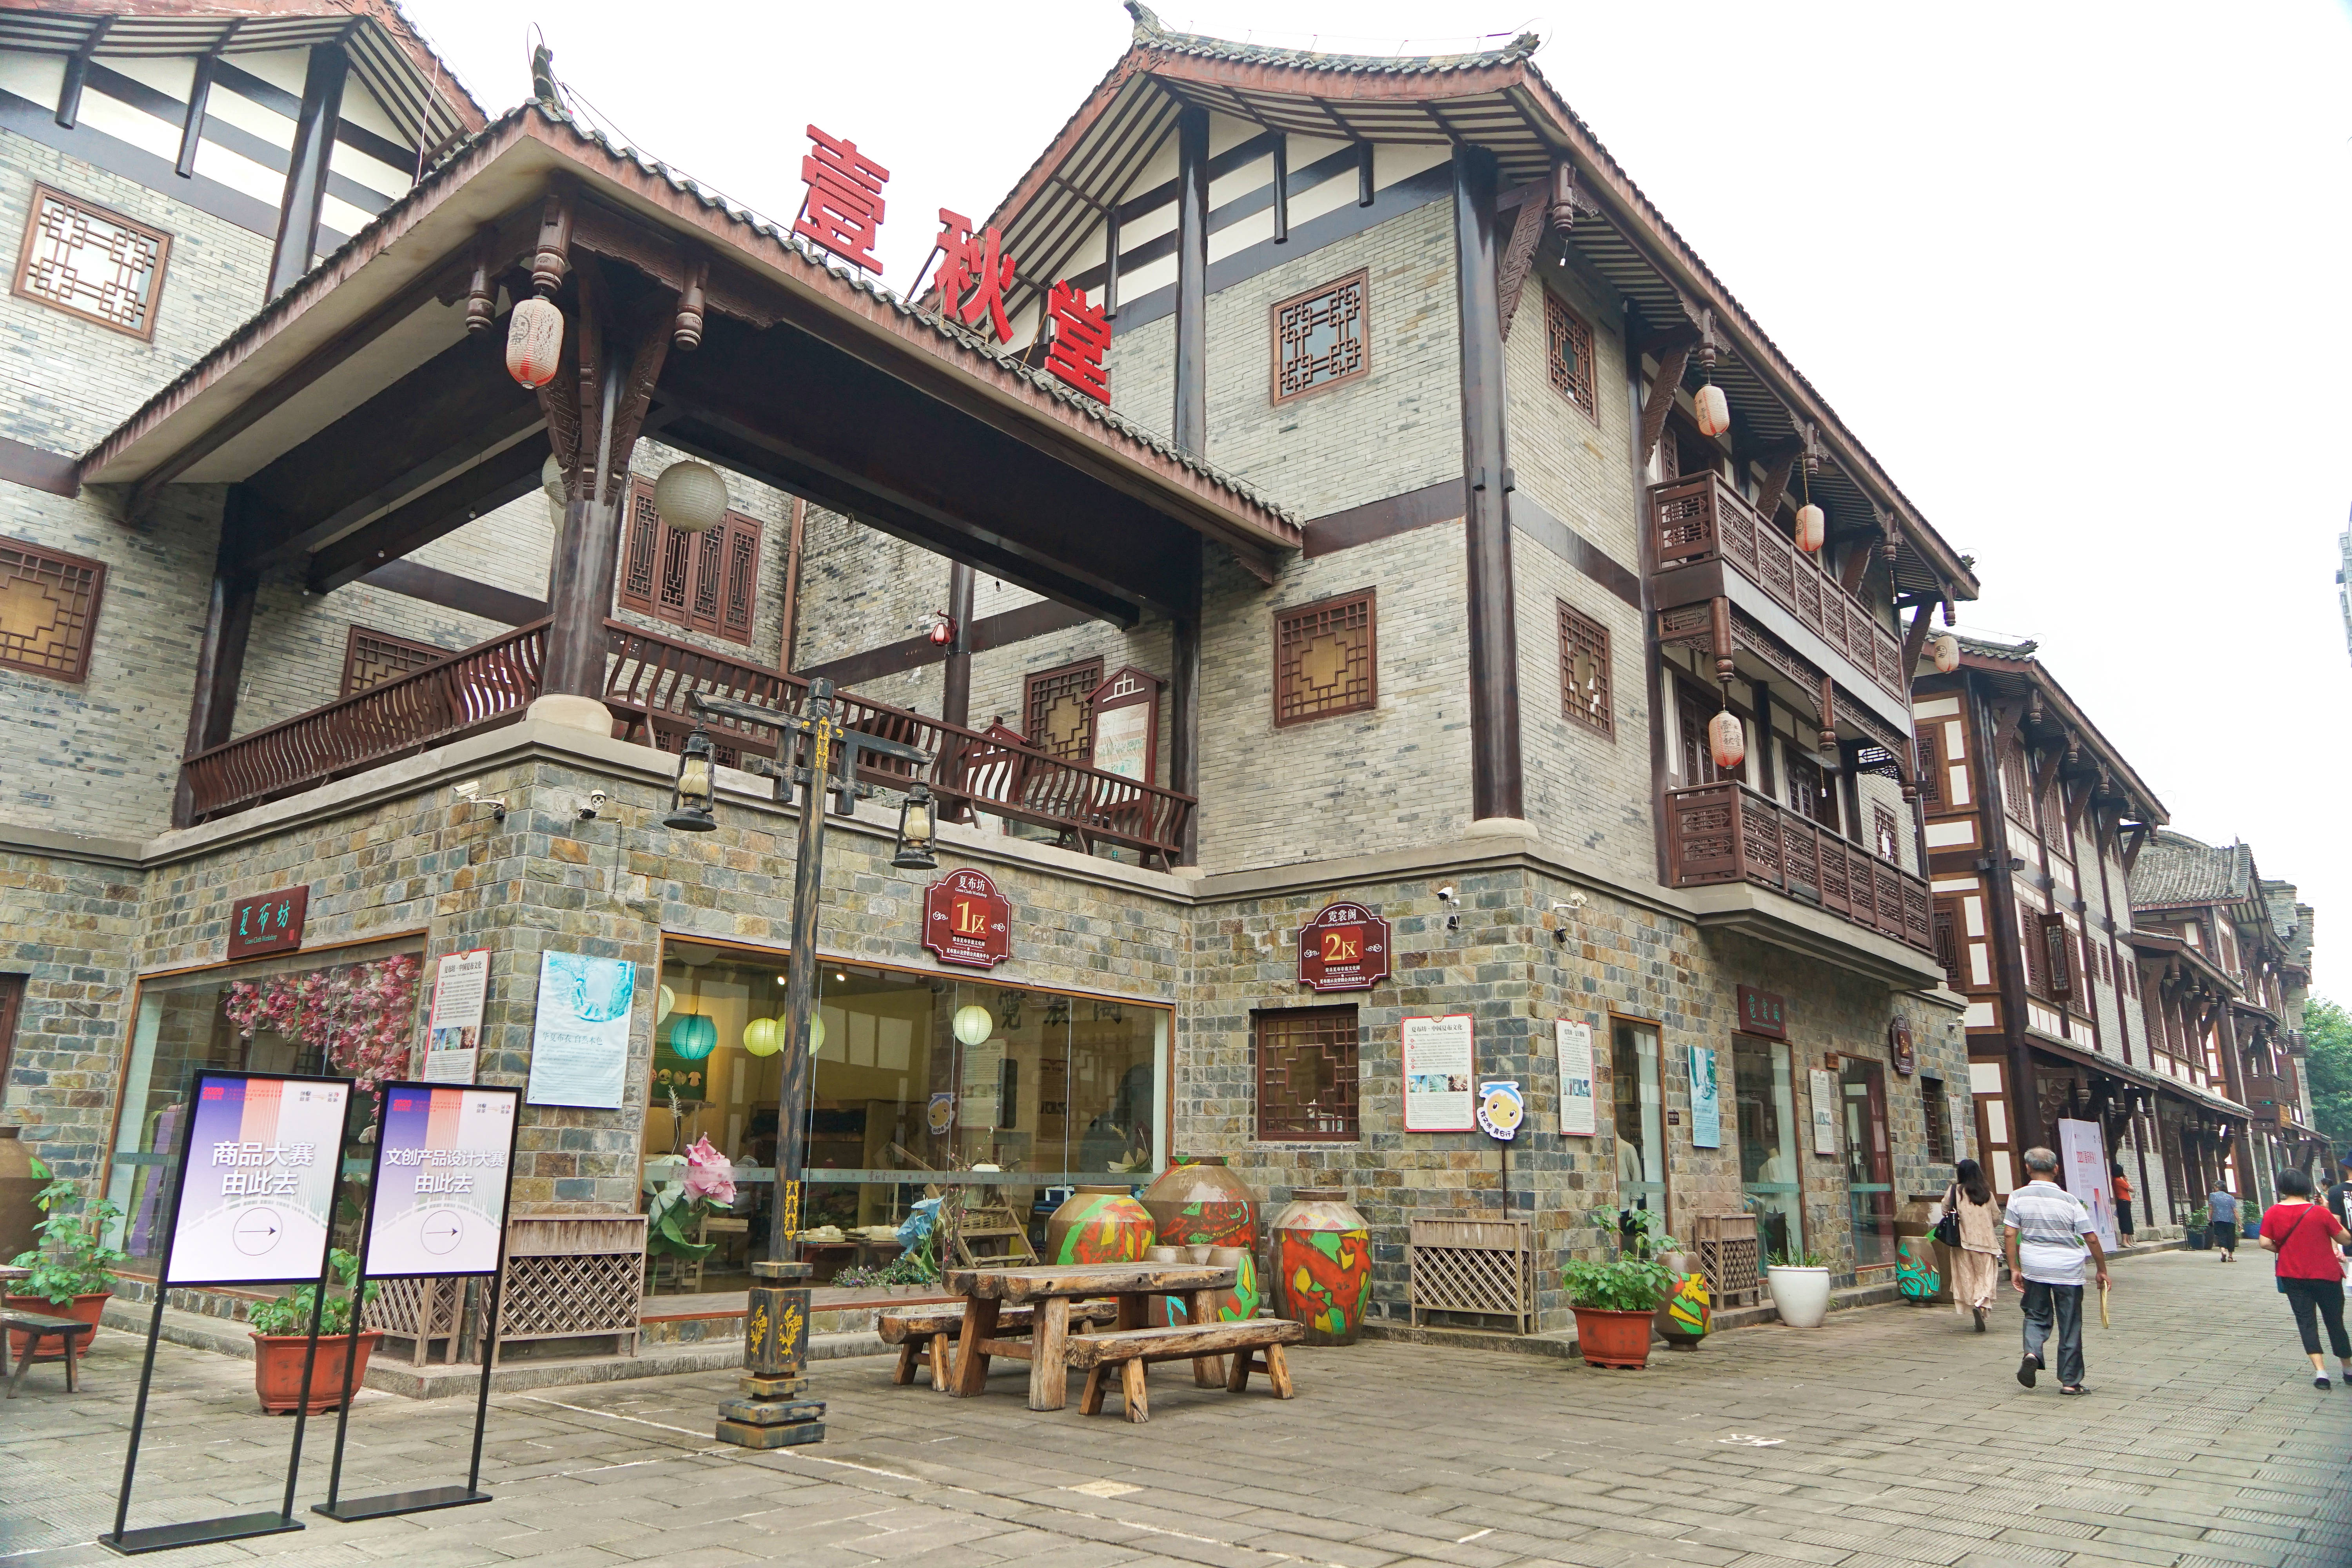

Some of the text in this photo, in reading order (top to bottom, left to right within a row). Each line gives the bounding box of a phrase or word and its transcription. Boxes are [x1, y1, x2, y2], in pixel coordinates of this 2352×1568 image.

[795, 124, 1111, 406] 壹秋堂
[958, 875, 985, 892] 夏布坊
[972, 890, 987, 898] Workshop
[239, 900, 290, 936] 夏布坊
[956, 901, 986, 934] 1区
[1328, 909, 1356, 923] 霓裳阁
[1325, 933, 1358, 962] 2区
[543, 1032, 571, 1043] 华夏布衣
[212, 1141, 315, 1167] 商品大赛
[385, 1148, 506, 1167] 文创产品设计大赛
[221, 1170, 298, 1196] 由此去
[414, 1172, 474, 1194] 由此去
